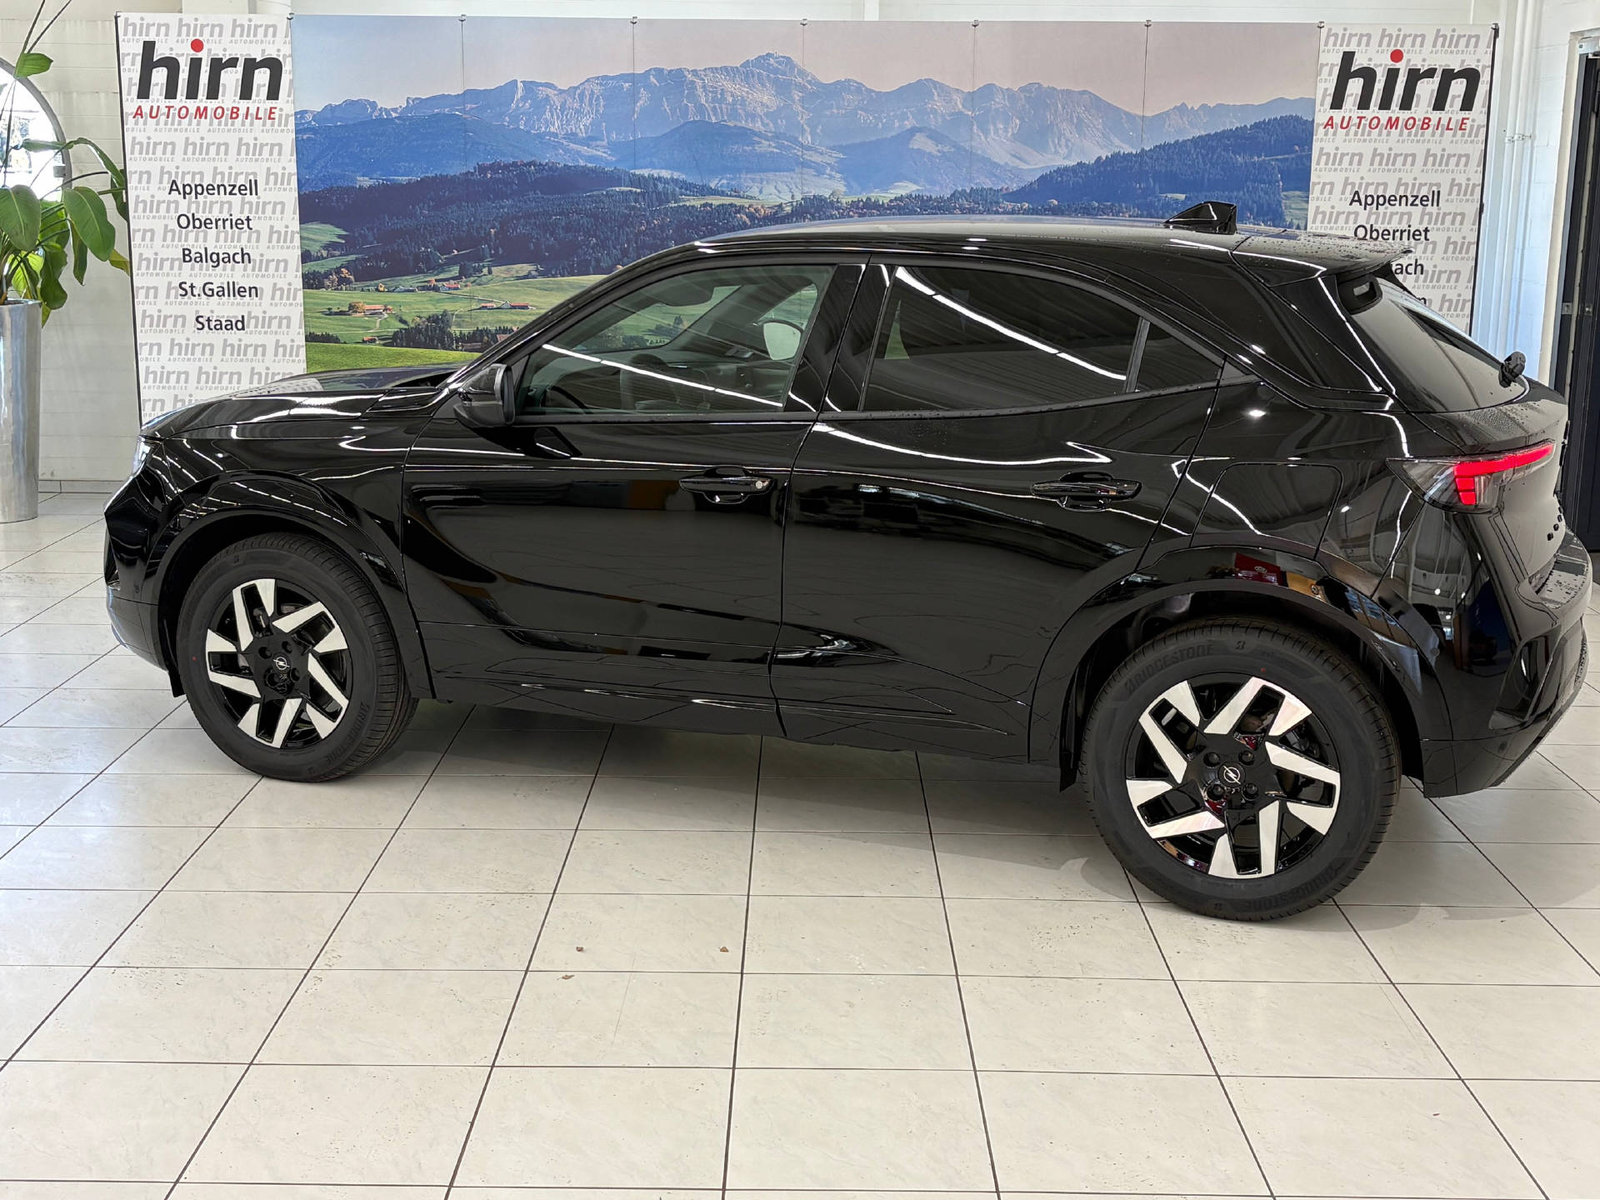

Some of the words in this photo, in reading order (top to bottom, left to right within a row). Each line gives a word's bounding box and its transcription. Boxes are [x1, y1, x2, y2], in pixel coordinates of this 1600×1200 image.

[122, 17, 170, 37] hirn
[176, 17, 224, 38] hirn
[230, 18, 278, 38] hirn
[1324, 27, 1372, 47] hirn
[1378, 27, 1426, 48] hirn
[1432, 28, 1480, 48] hirn
[137, 39, 283, 100] hirn
[1329, 49, 1481, 111] hirn
[132, 105, 278, 120] AUTOMOBILE
[1323, 115, 1470, 131] AUTOMOBILE
[130, 136, 176, 155] hirn
[183, 136, 230, 156] hirn
[236, 137, 283, 156] hirn
[1315, 147, 1364, 166] hirn
[1369, 147, 1417, 167] hirn
[1423, 148, 1471, 167] hirn
[128, 169, 151, 184] rn
[265, 167, 297, 186] hir
[168, 179, 259, 200] Appenzell
[1311, 181, 1335, 195] rn
[1447, 177, 1481, 197] hir
[133, 195, 180, 213] hirn
[186, 195, 233, 214] hirn
[239, 195, 286, 215] hirn
[1349, 190, 1441, 210] Appenzell
[176, 213, 253, 230] Oberriet
[1312, 205, 1360, 225] hirn
[1365, 206, 1413, 225] hirn
[1418, 207, 1466, 226] hirn
[132, 228, 156, 242] rn
[162, 224, 208, 243] hirn
[267, 225, 300, 244] hir
[1354, 224, 1430, 241] Oberriet
[1443, 236, 1475, 255] hir
[136, 252, 182, 271] hirn
[182, 247, 251, 268] Balgach
[135, 286, 159, 299] rn
[270, 282, 301, 301] hir
[178, 281, 259, 298] St.Gallen
[1438, 293, 1471, 312] hir
[140, 309, 187, 328] hirn
[195, 315, 246, 331] Staad
[139, 342, 162, 356] rn
[169, 337, 215, 356] hirn
[221, 338, 267, 357] hirn
[273, 339, 305, 358] hir
[143, 365, 190, 384] hirn
[196, 366, 242, 385] hirn
[143, 399, 166, 412] rn
